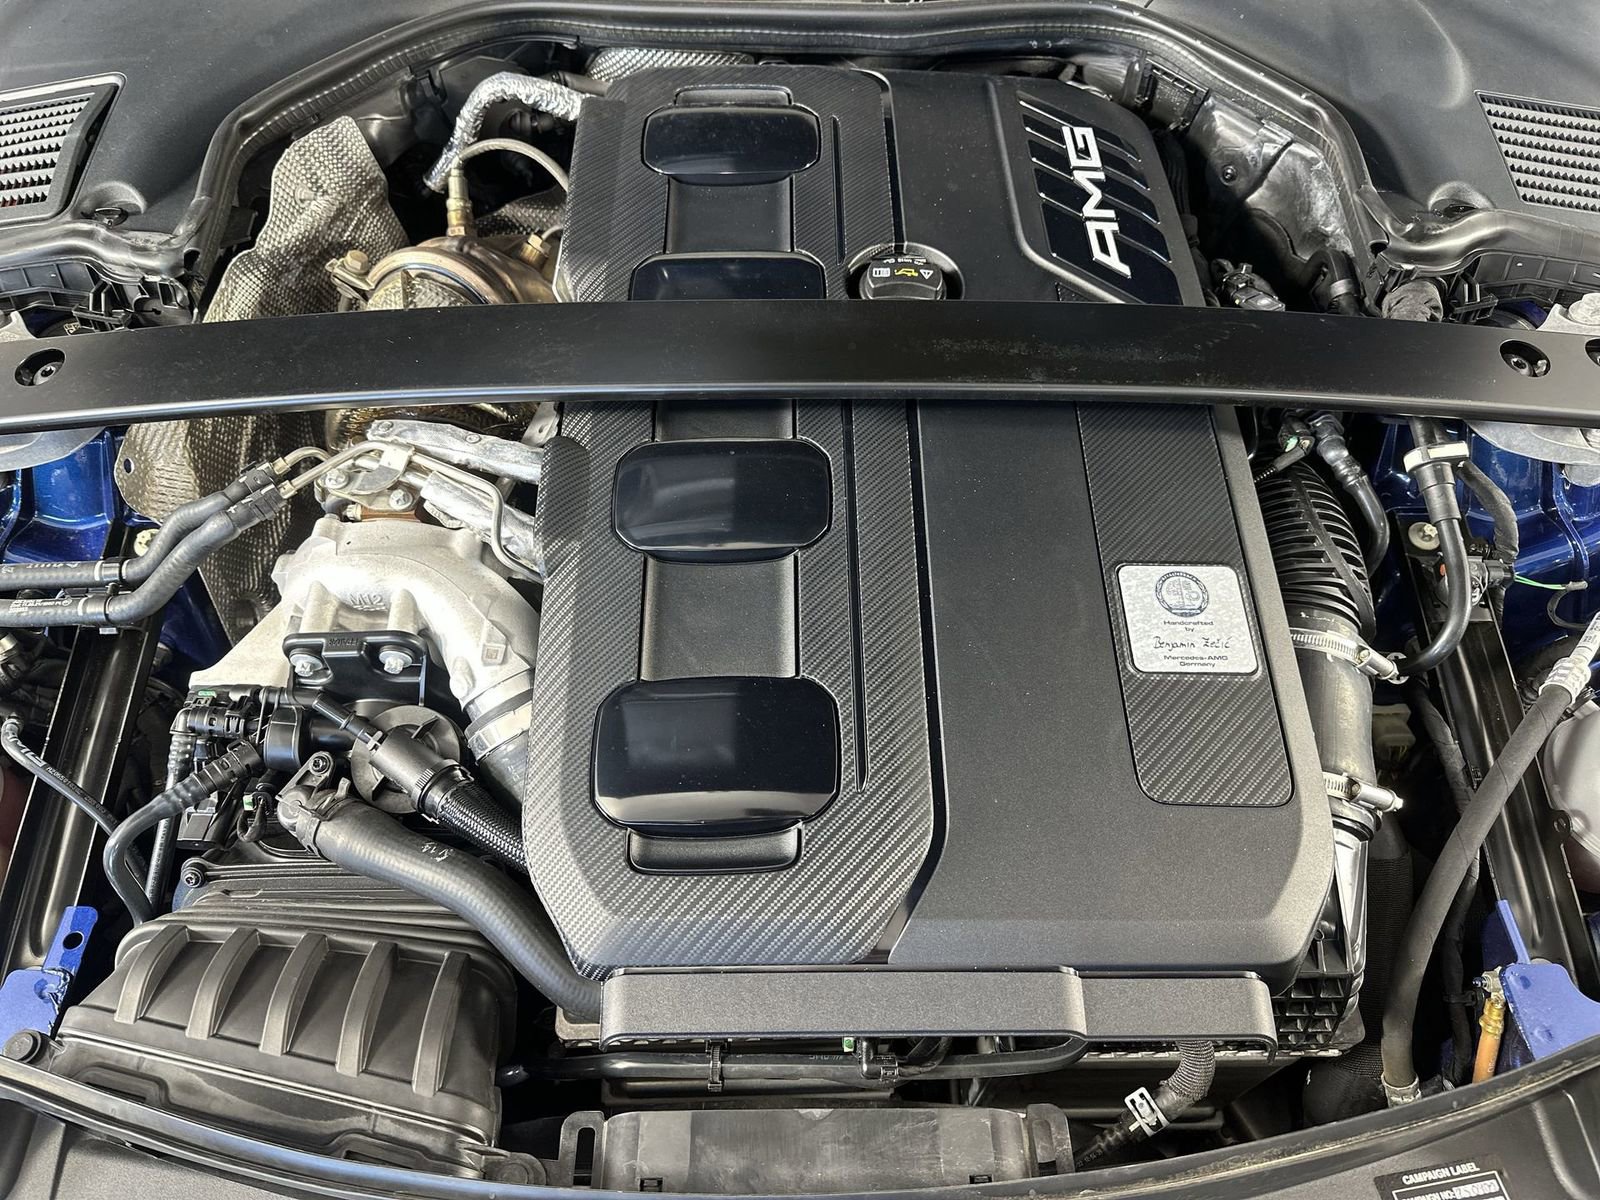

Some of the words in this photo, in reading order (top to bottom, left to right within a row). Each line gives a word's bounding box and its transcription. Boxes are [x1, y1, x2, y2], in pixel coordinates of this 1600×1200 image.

[1062, 126, 1132, 279] AMG
[1153, 635, 1196, 652] Benjamin
[1402, 1168, 1451, 1185] CAMPAIGN
[1449, 1162, 1480, 1176] LABEL
